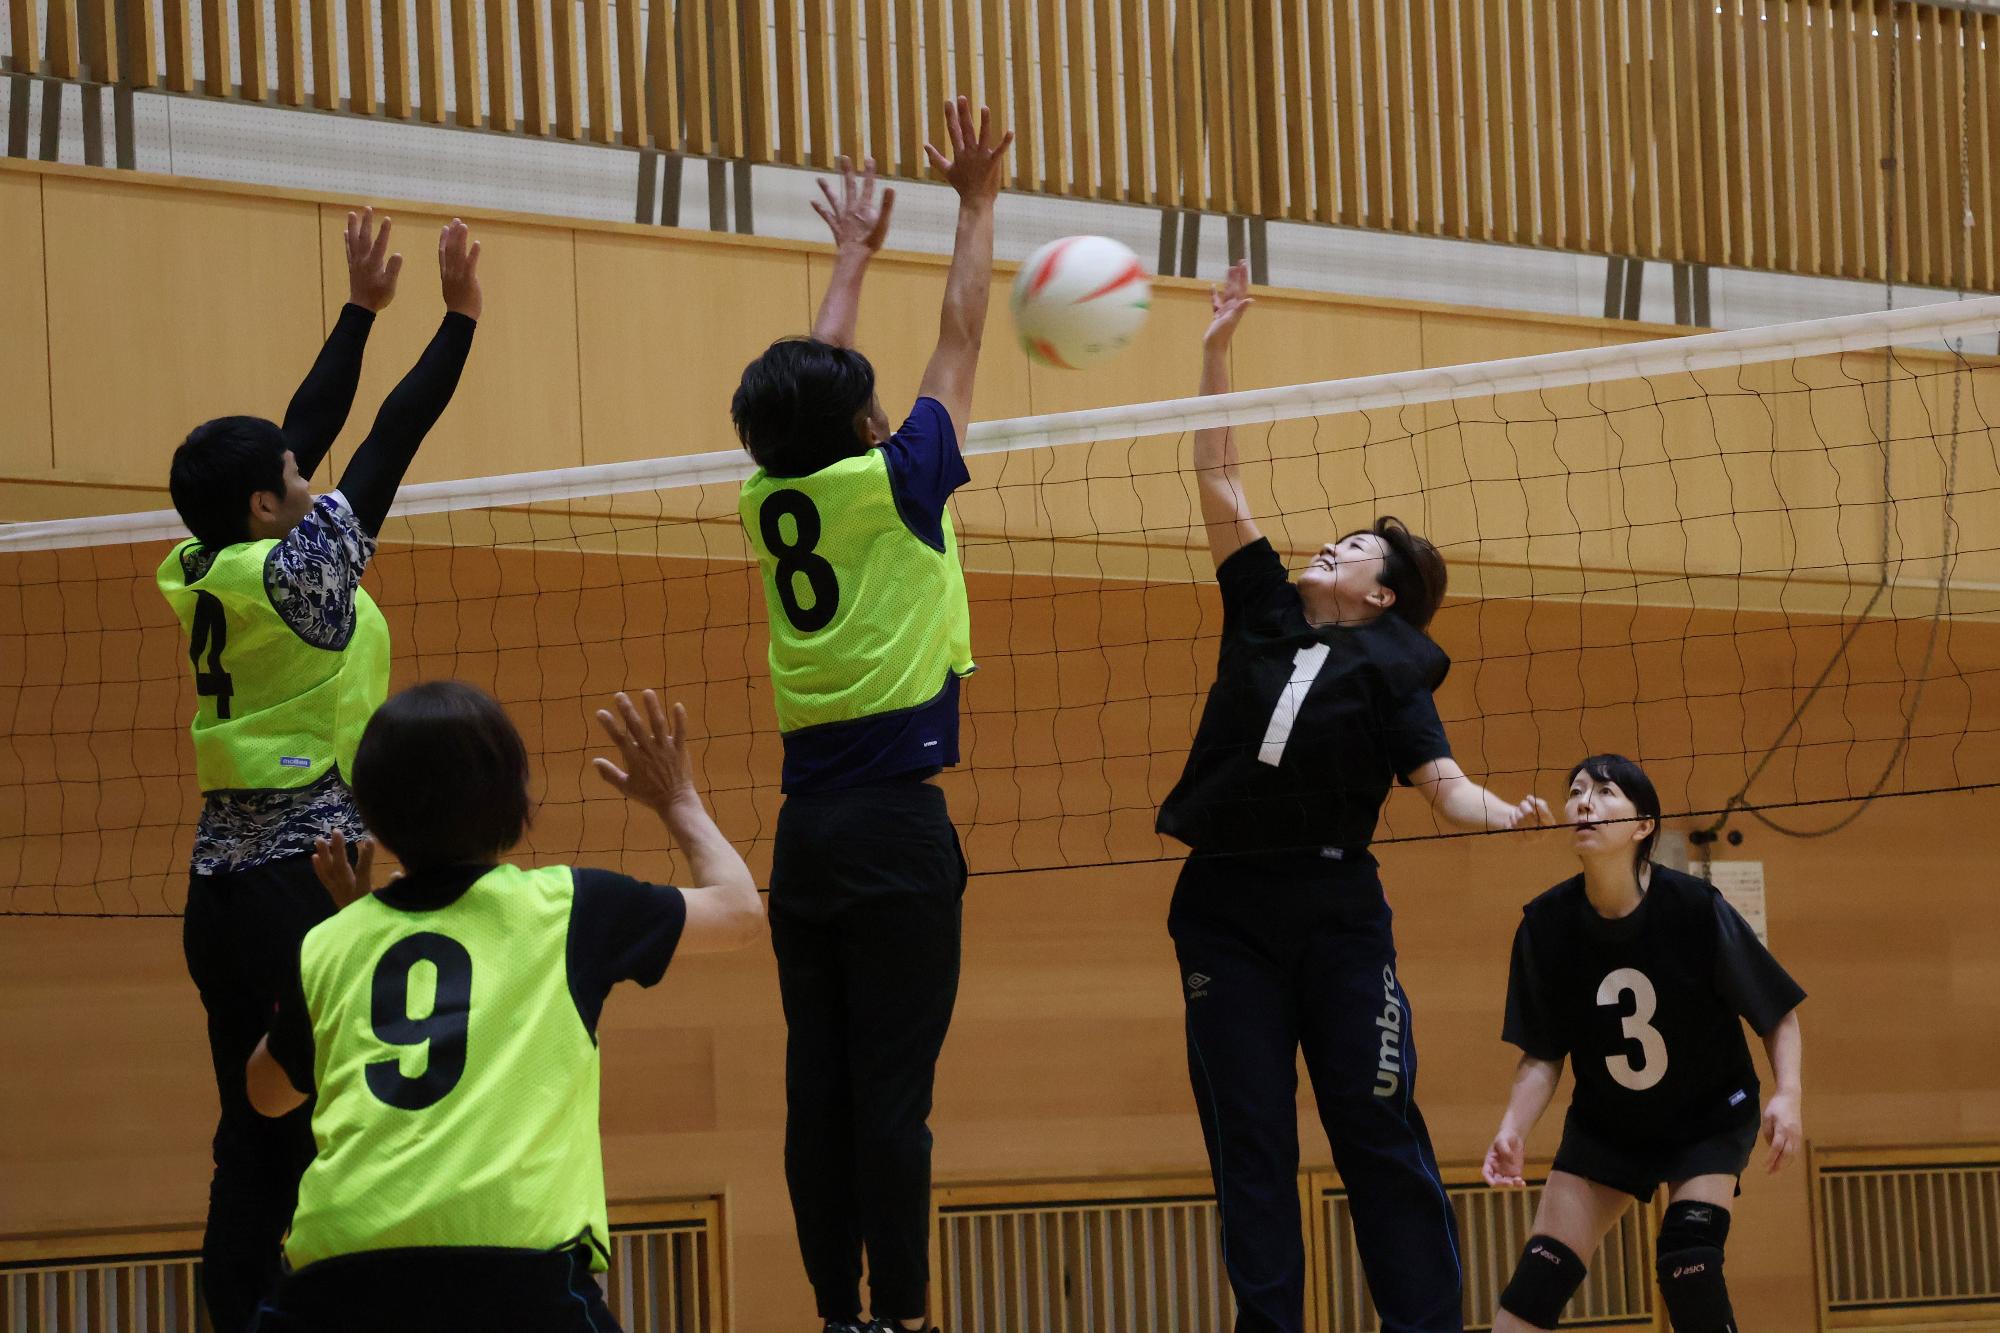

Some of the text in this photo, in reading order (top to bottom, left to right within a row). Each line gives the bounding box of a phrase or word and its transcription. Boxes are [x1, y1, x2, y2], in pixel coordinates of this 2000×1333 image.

[759, 488, 840, 633] 8
[190, 588, 234, 719] 4
[1257, 642, 1331, 767] 1
[365, 931, 472, 1111] 9
[1373, 963, 1400, 1098] umbro
[1596, 967, 1669, 1089] 3
